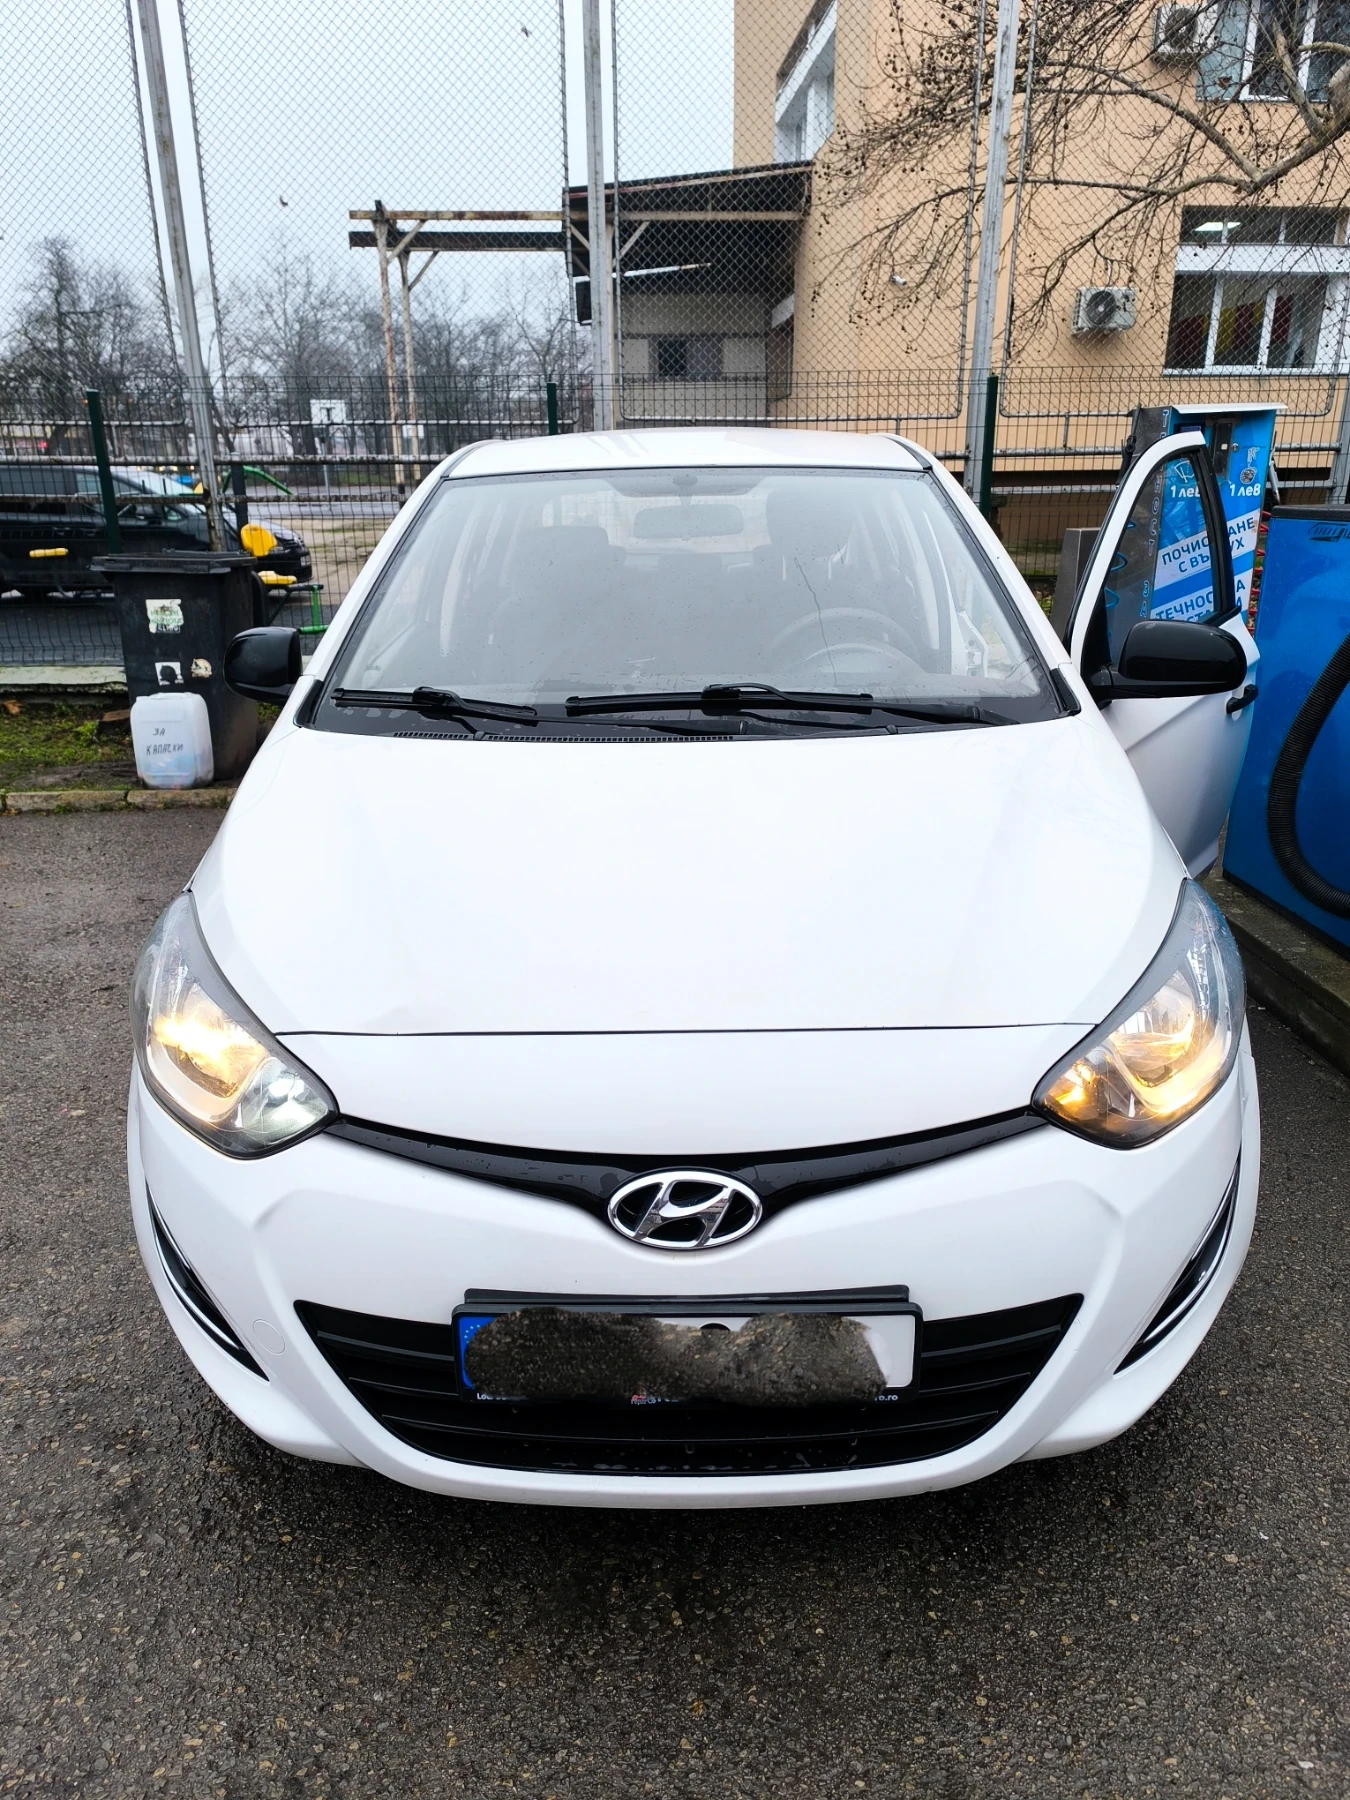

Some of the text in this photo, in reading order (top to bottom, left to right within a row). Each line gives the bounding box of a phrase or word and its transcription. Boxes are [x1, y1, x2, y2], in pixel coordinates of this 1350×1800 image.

[1170, 485, 1176, 498] 1
[1229, 483, 1261, 497] 1 лев
